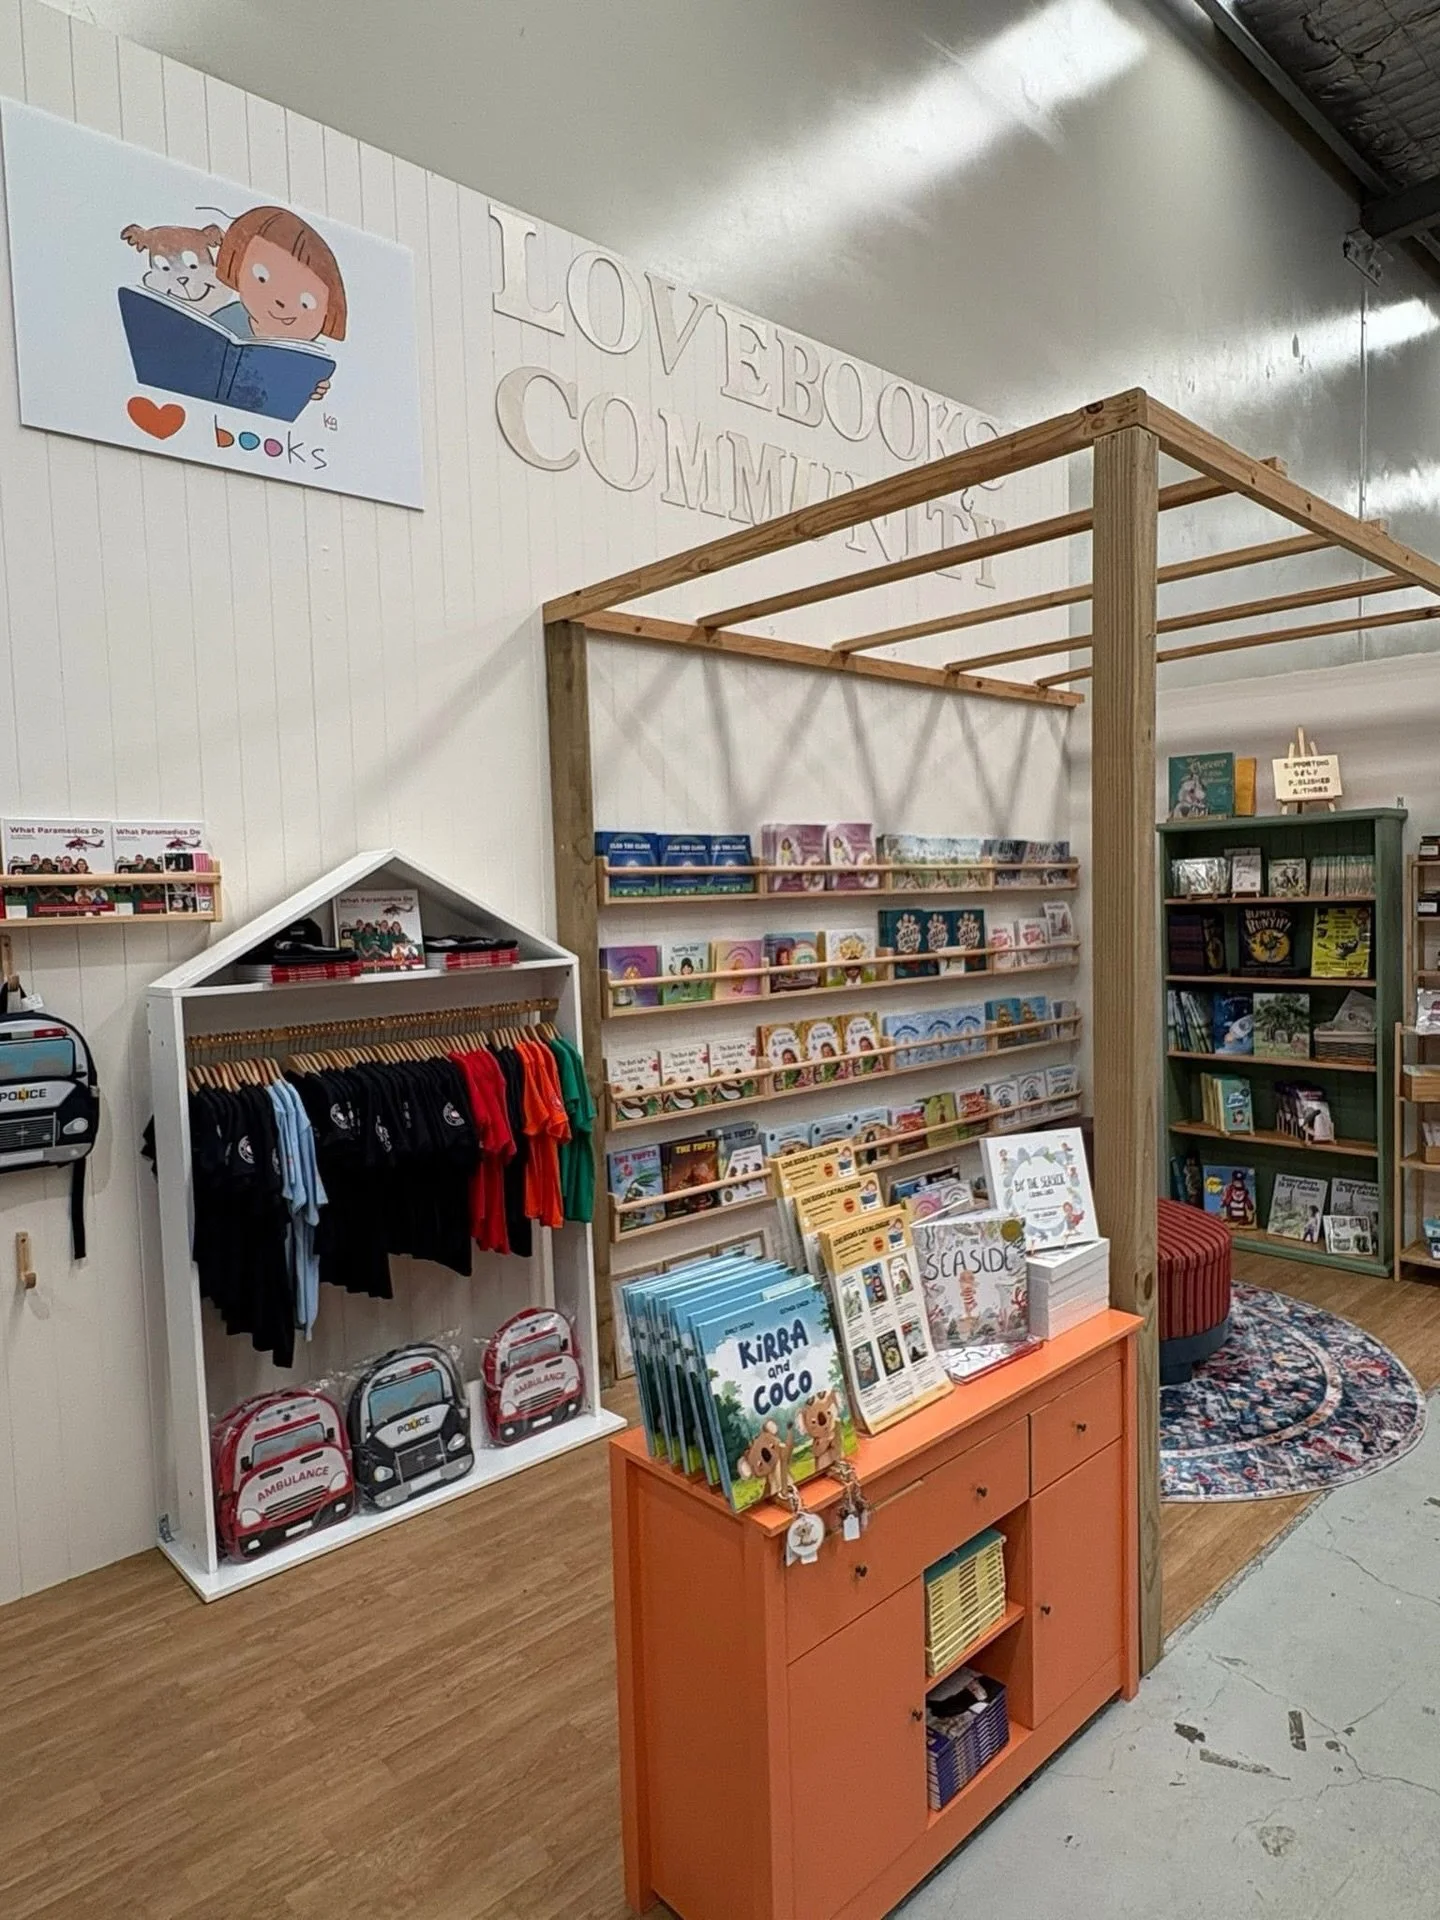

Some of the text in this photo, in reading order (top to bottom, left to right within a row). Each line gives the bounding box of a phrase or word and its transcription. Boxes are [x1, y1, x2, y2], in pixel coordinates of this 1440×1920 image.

[214, 413, 328, 470] books
[496, 366, 1005, 589] COMMUNITY
[1284, 759, 1329, 769] SPPORTING
[1288, 777, 1330, 786] PBLISHED
[1293, 786, 1328, 794] ATHORS
[10, 826, 104, 835] What Paramedics Do
[116, 828, 139, 836] What
[141, 828, 190, 836] Paramedics
[0, 1088, 47, 1101] POLICE
[809, 1147, 839, 1160] CATALOGUE
[826, 1181, 861, 1196] CATALOGUE
[858, 1220, 890, 1236] CATALOGUE
[923, 1246, 1013, 1280] SEASIDE
[767, 1359, 790, 1379] and
[512, 1370, 567, 1397] AMBULANCE
[753, 1370, 812, 1415] COCO
[396, 1413, 431, 1435] POLICE
[256, 1465, 330, 1501] AMBULANCE
